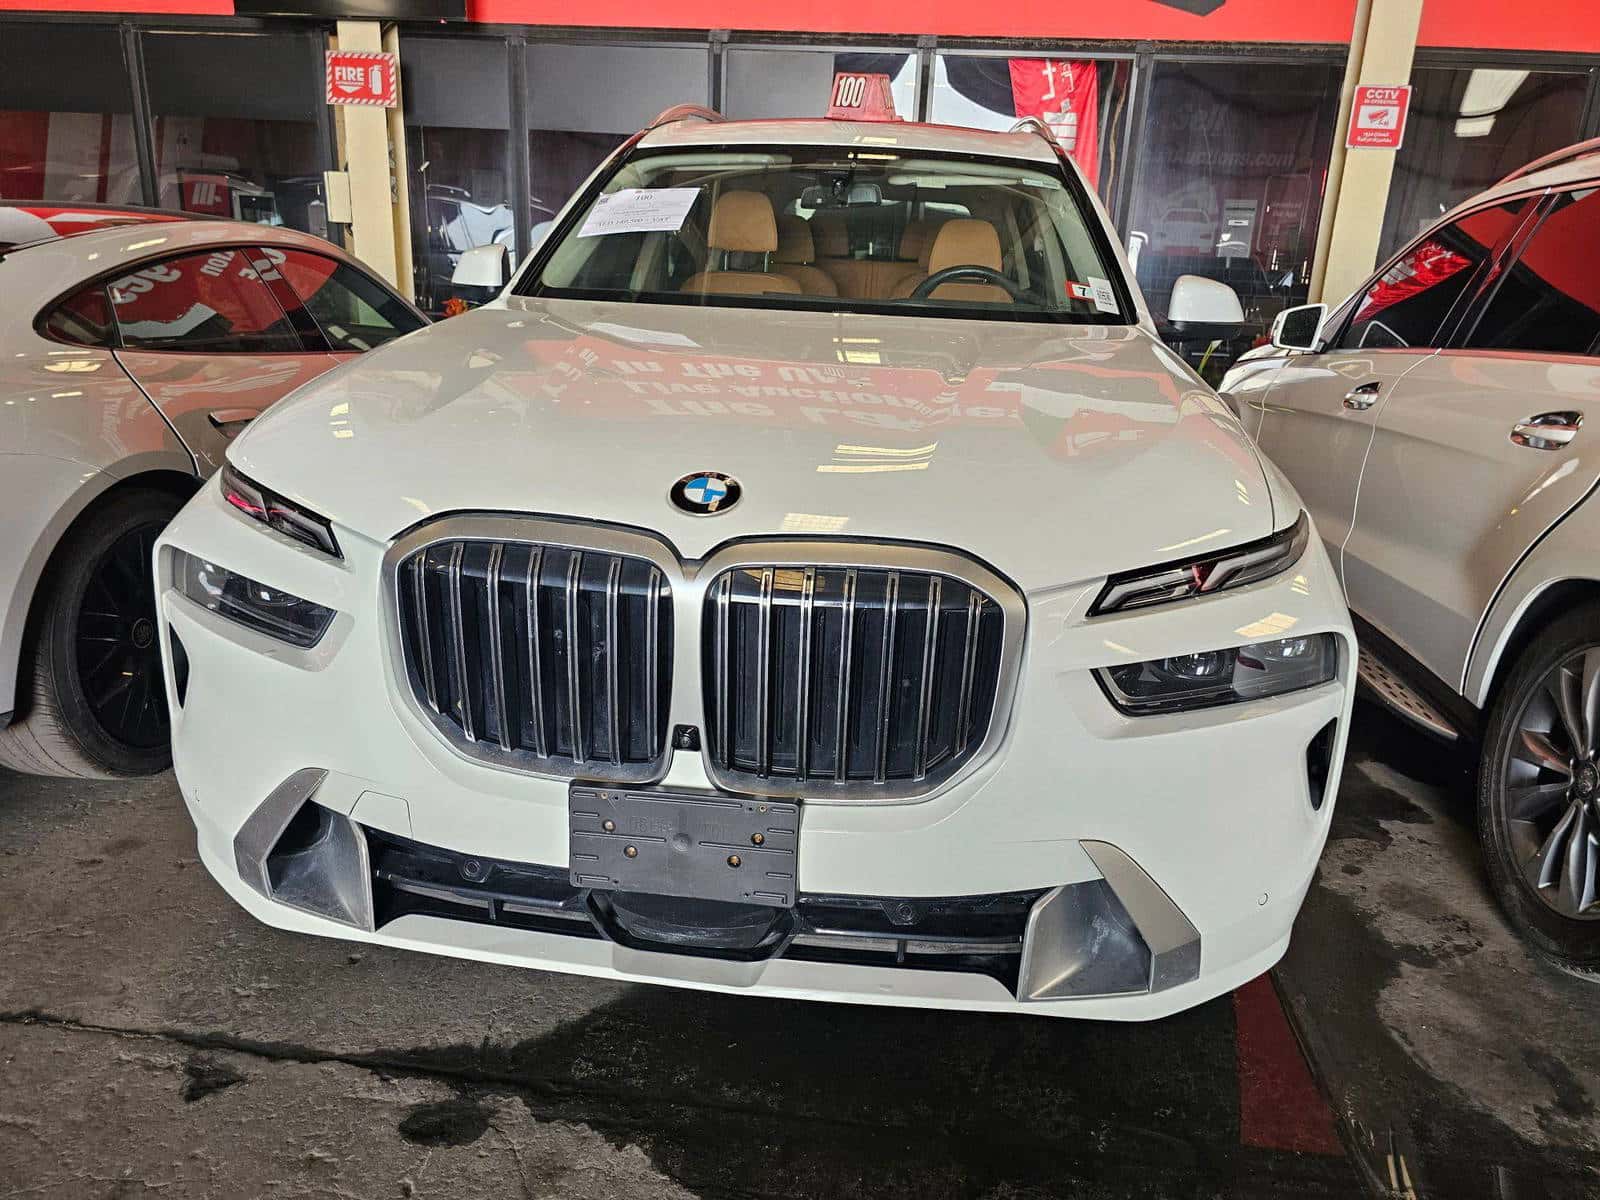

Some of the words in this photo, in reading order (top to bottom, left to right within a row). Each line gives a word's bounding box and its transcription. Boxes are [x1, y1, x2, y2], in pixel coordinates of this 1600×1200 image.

[334, 66, 365, 81] FIRE
[834, 76, 866, 107] 100
[1366, 89, 1400, 99] CCTV
[1078, 286, 1087, 296] 7
